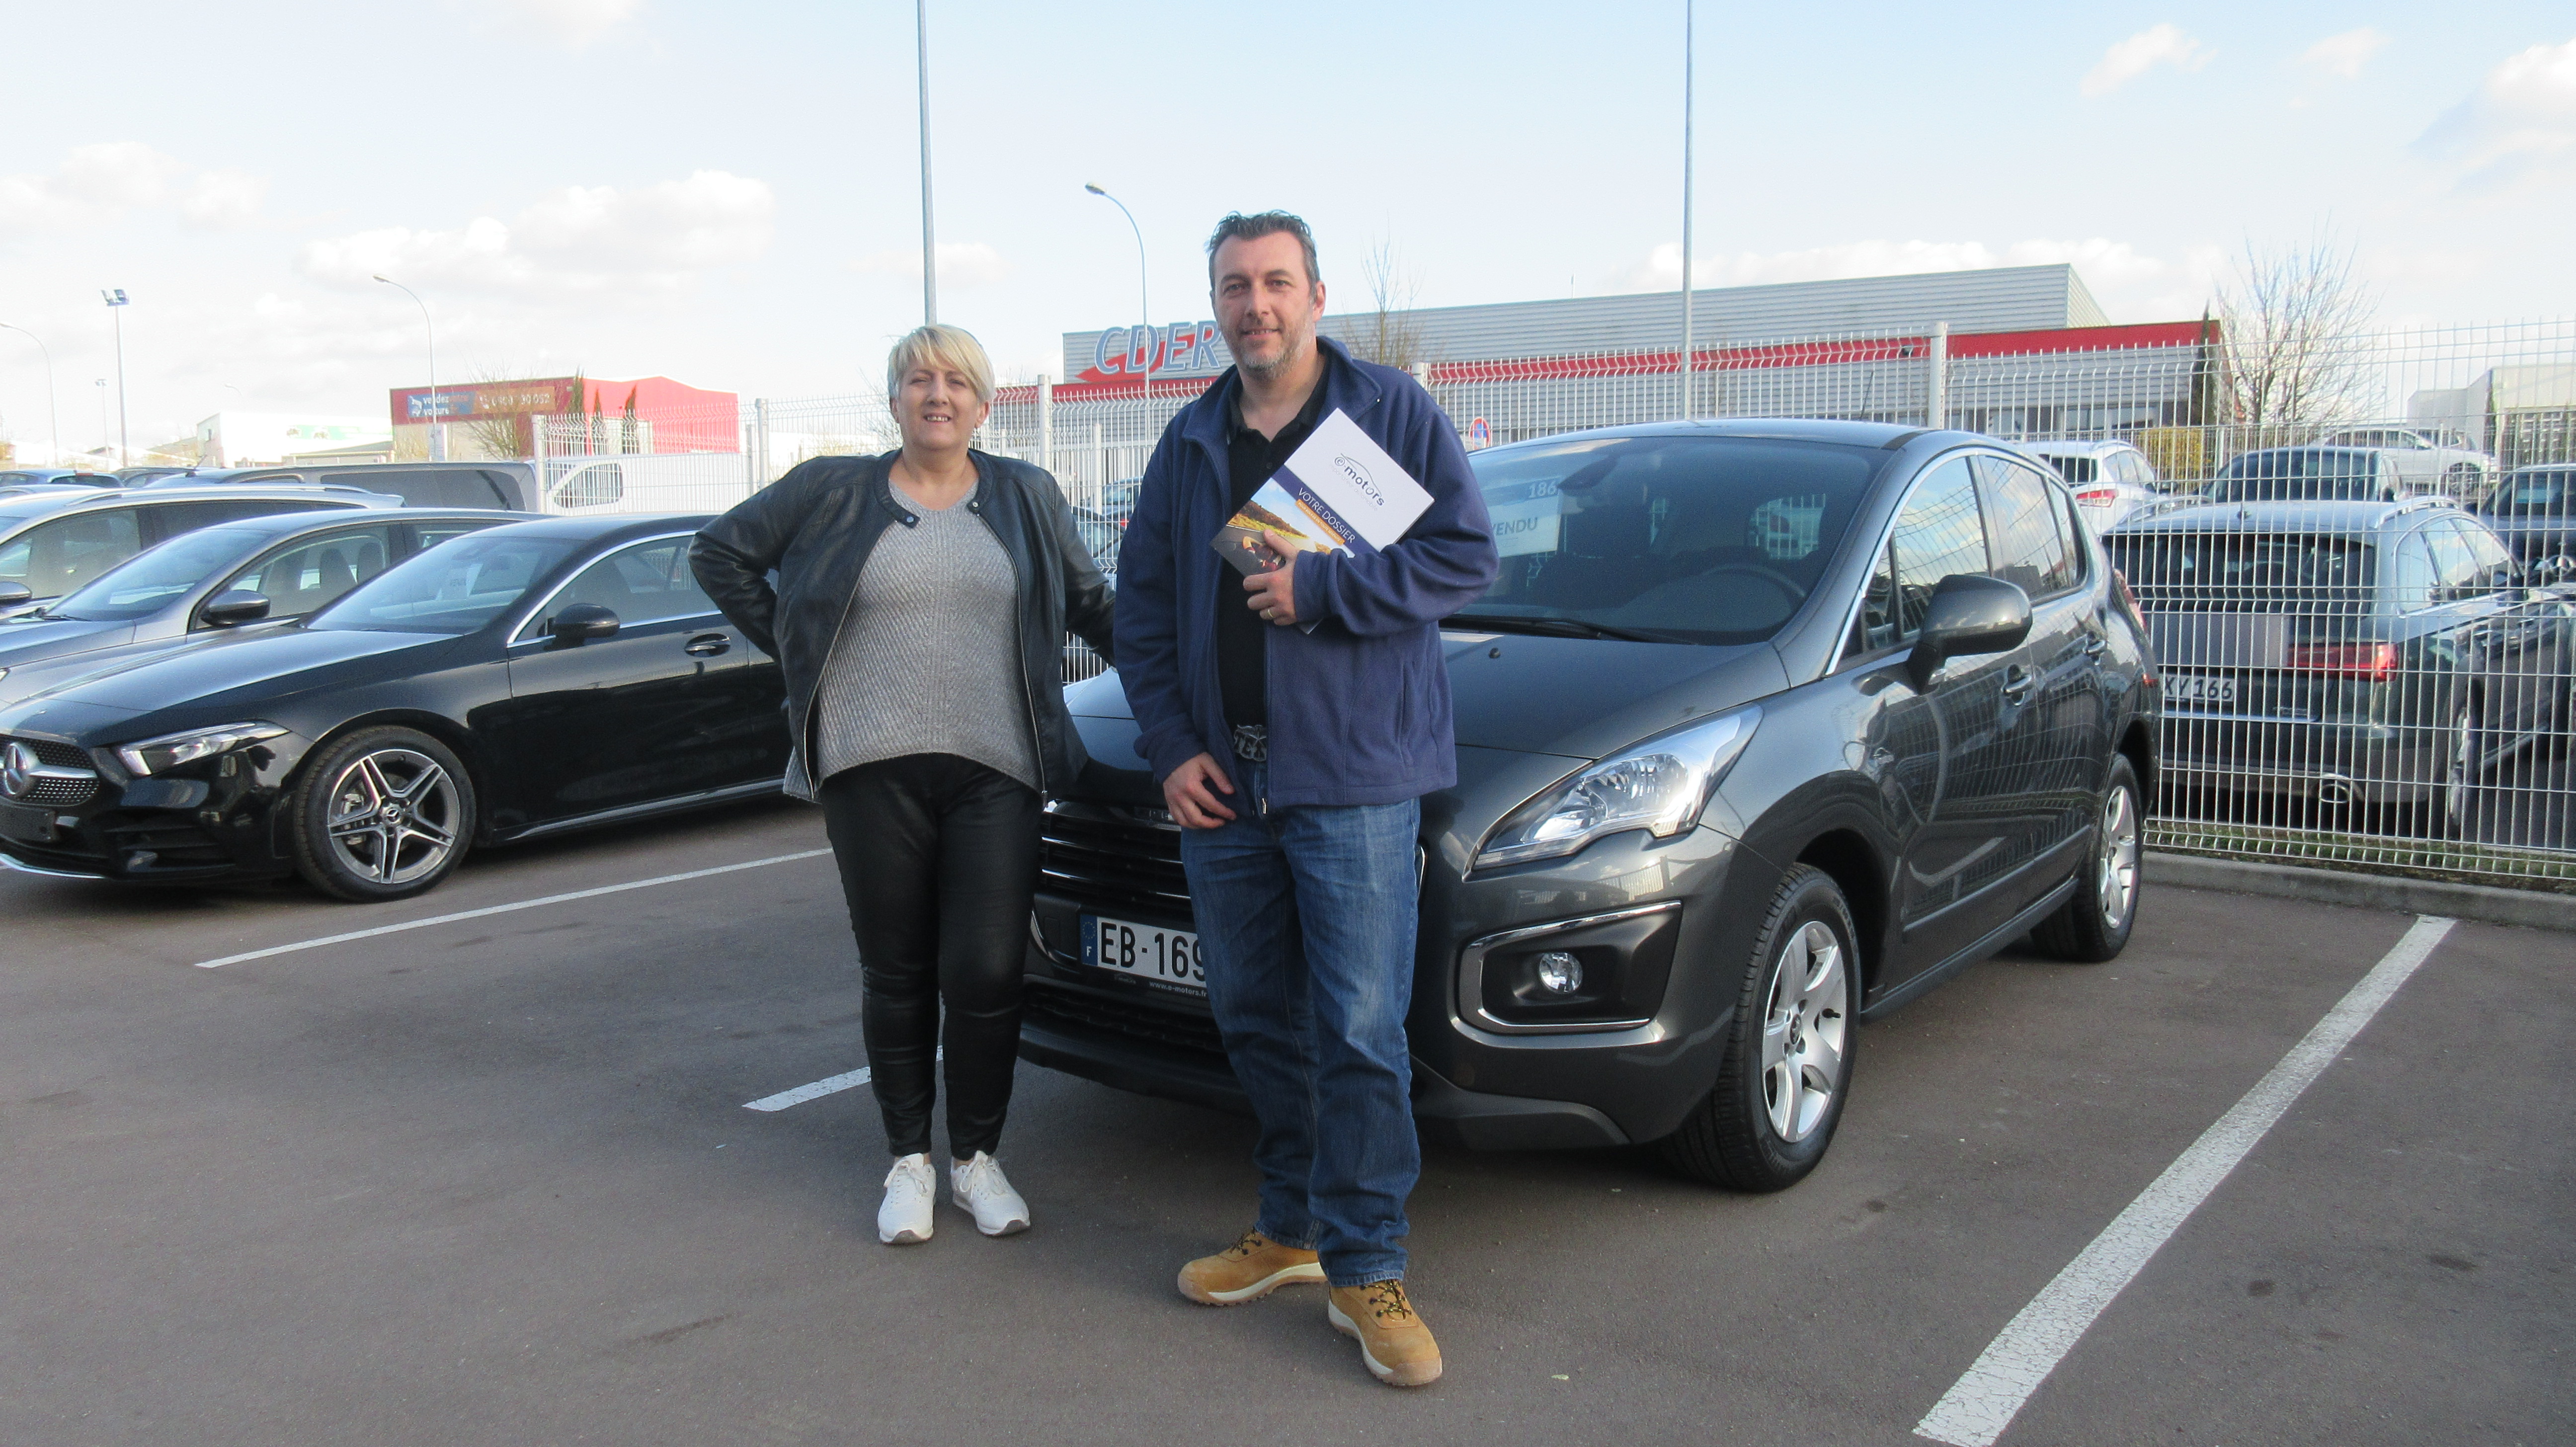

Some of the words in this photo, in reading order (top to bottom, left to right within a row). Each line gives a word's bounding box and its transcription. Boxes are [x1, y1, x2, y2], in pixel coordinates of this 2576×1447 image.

[1095, 320, 1221, 374] CDER
[423, 394, 449, 404] vedez
[424, 407, 449, 416] voture
[1529, 482, 1558, 497] 186
[1298, 487, 1325, 514] VOTRE
[1321, 510, 1356, 543] DOSSIER
[2193, 679, 2232, 699] 166
[1087, 946, 1092, 957] F
[1149, 981, 1207, 997] www.e-motors.fr
